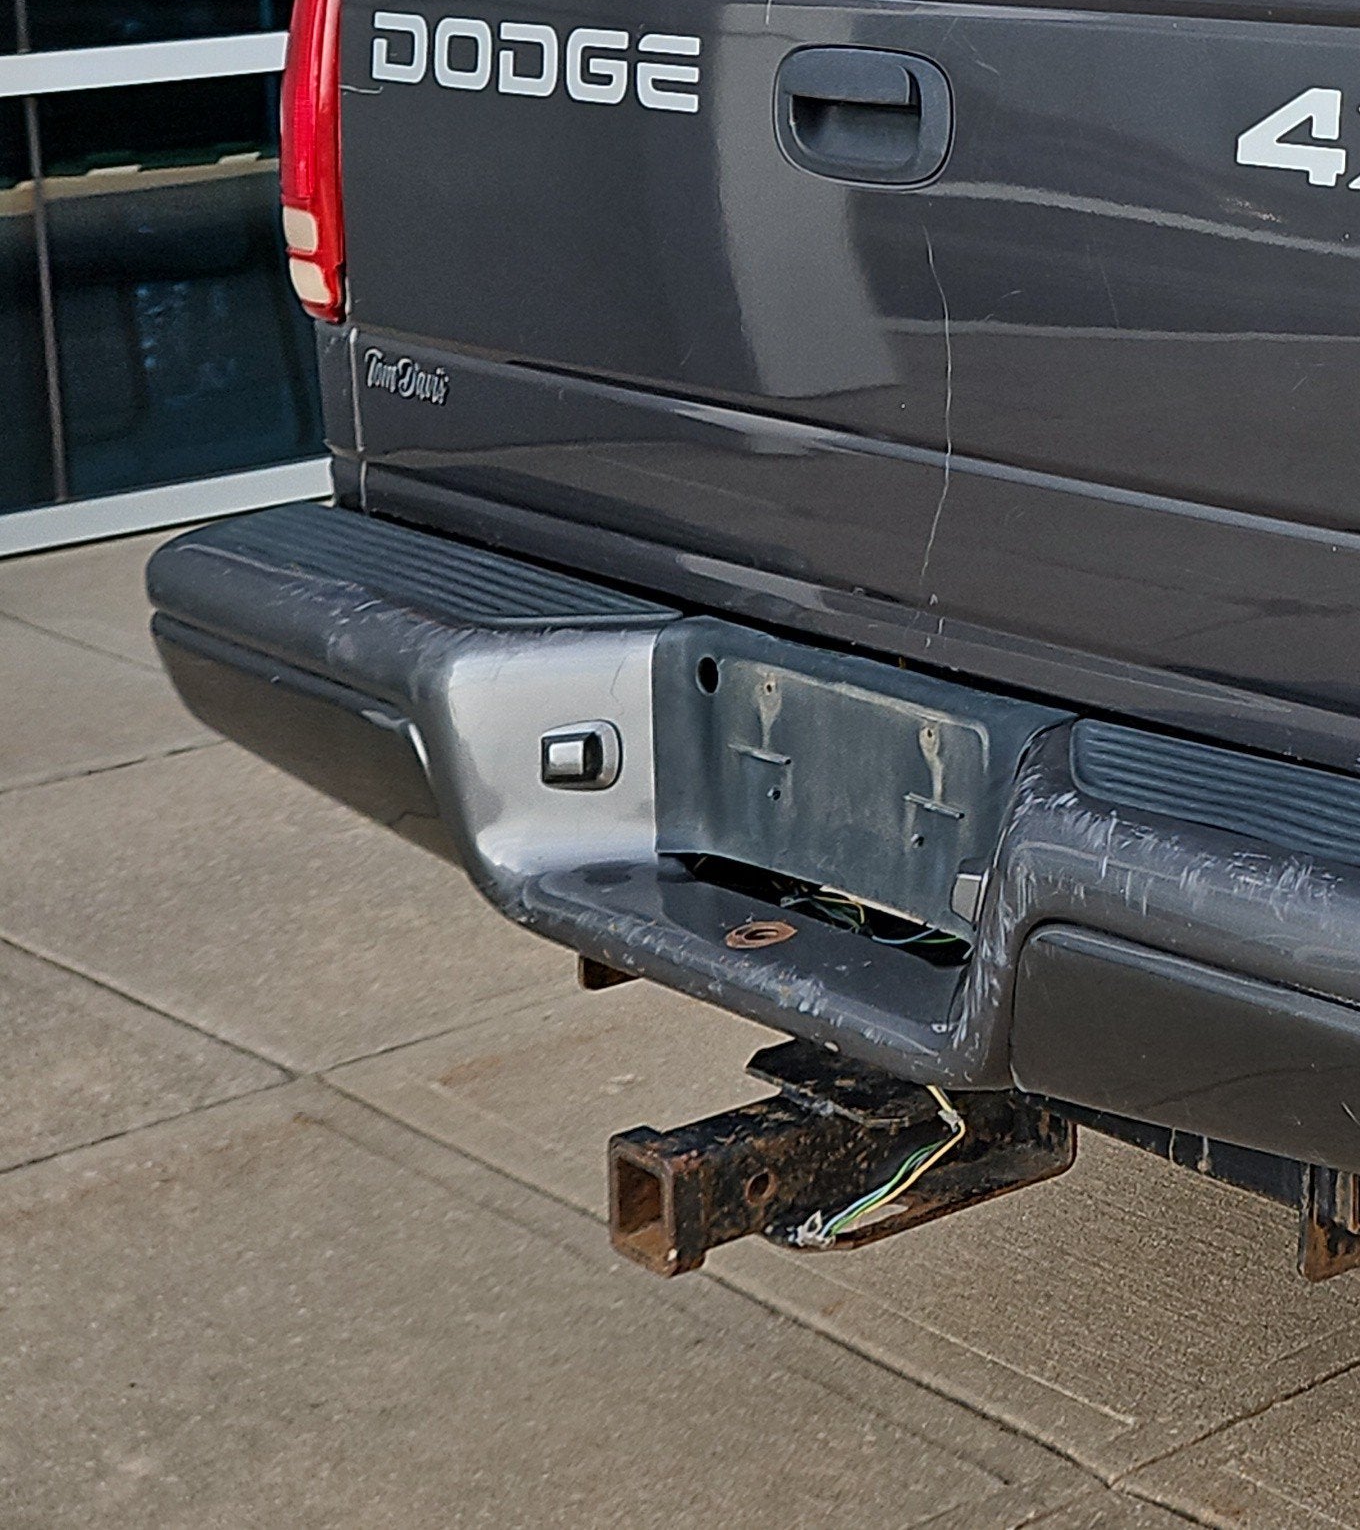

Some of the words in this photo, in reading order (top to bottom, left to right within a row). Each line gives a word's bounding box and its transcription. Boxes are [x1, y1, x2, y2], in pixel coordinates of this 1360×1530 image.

[371, 11, 702, 114] DODGE
[363, 347, 397, 394] Tom
[396, 357, 450, 406] Davis
